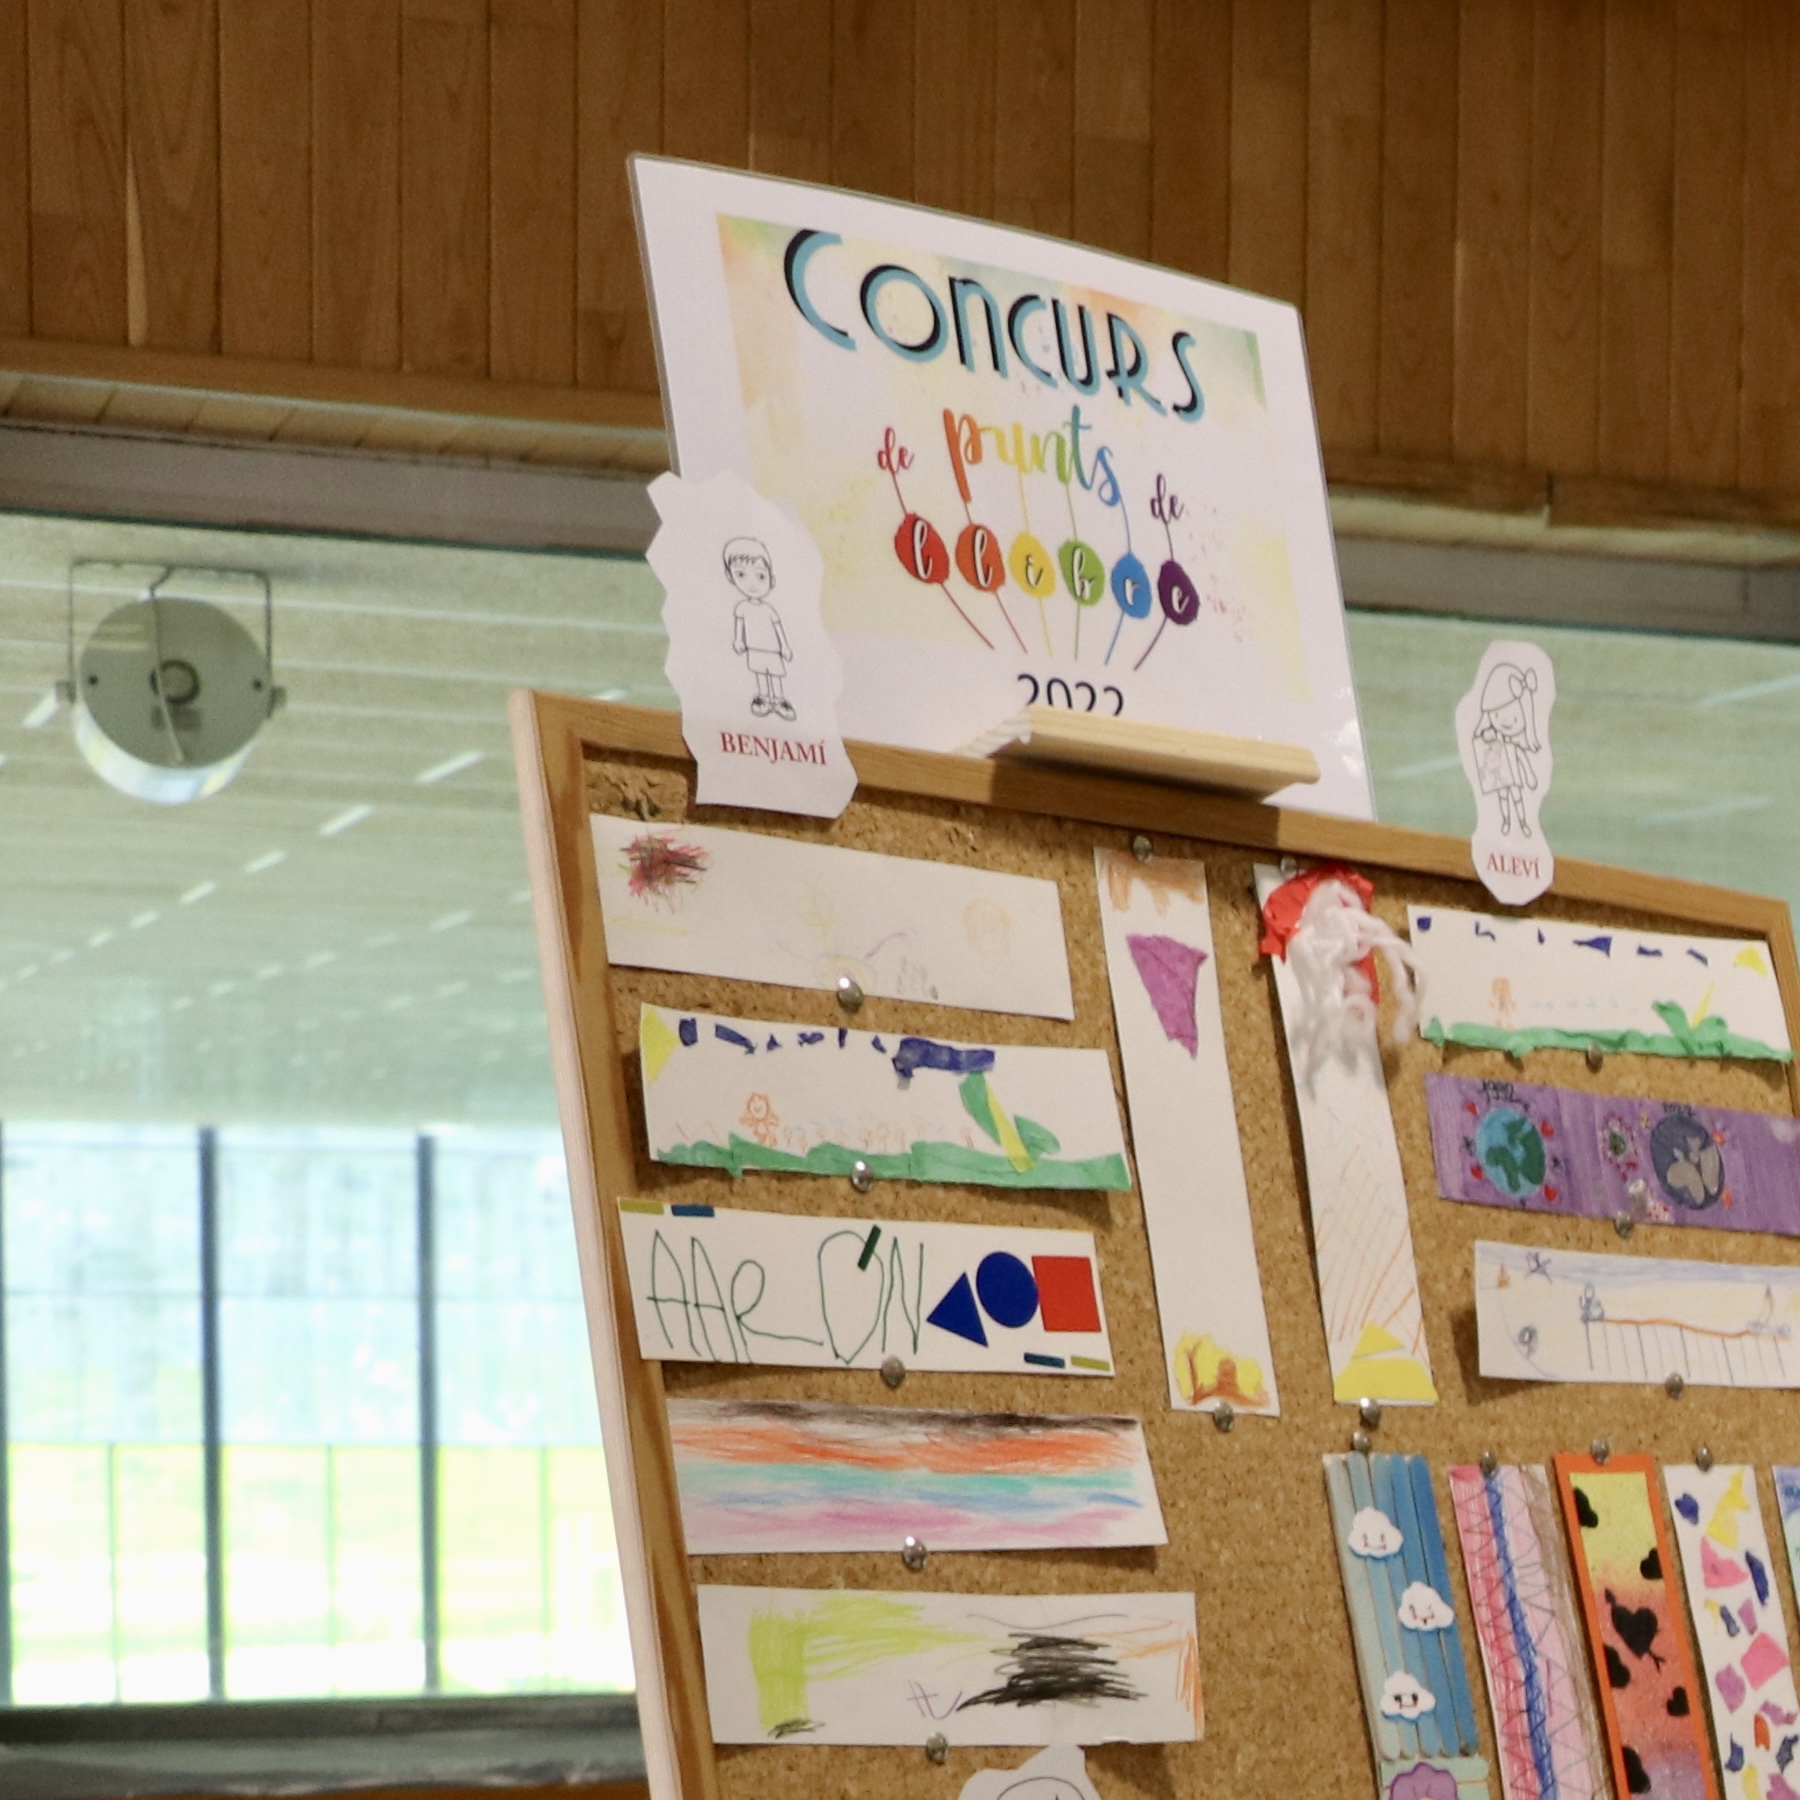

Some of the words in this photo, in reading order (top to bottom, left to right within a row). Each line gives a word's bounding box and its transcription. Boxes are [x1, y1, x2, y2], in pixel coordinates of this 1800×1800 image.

[784, 229, 1205, 424] CONCURS
[877, 426, 914, 475] de
[942, 404, 1123, 507] punts
[1151, 473, 1185, 525] de
[720, 730, 828, 766] BENJAMÍ
[1486, 852, 1540, 880] ALEVÍ
